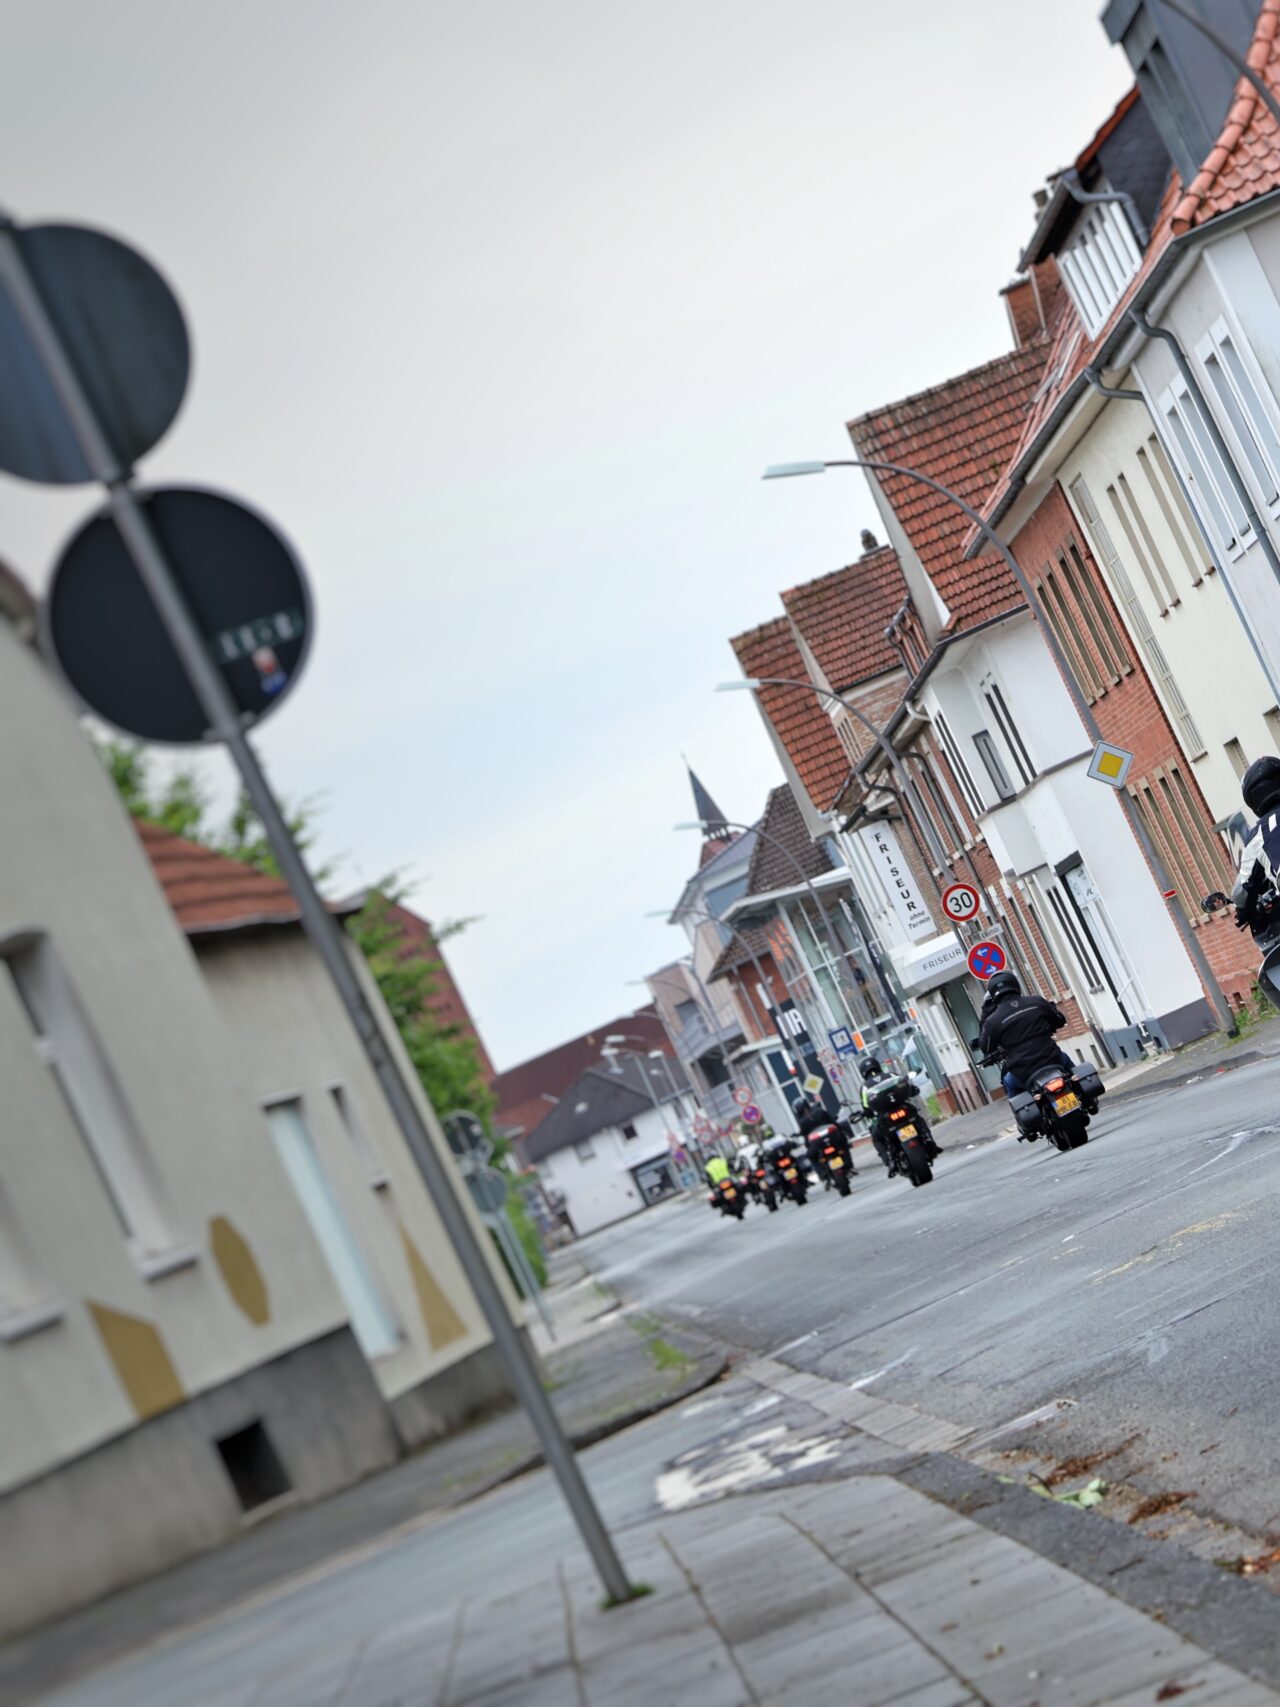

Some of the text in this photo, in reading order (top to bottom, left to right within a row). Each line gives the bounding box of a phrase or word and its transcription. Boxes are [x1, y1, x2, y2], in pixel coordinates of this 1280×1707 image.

[874, 832, 917, 912] FRISEUR
[949, 892, 973, 913] 30
[908, 916, 931, 930] Termin
[922, 948, 963, 971] FRISEUR
